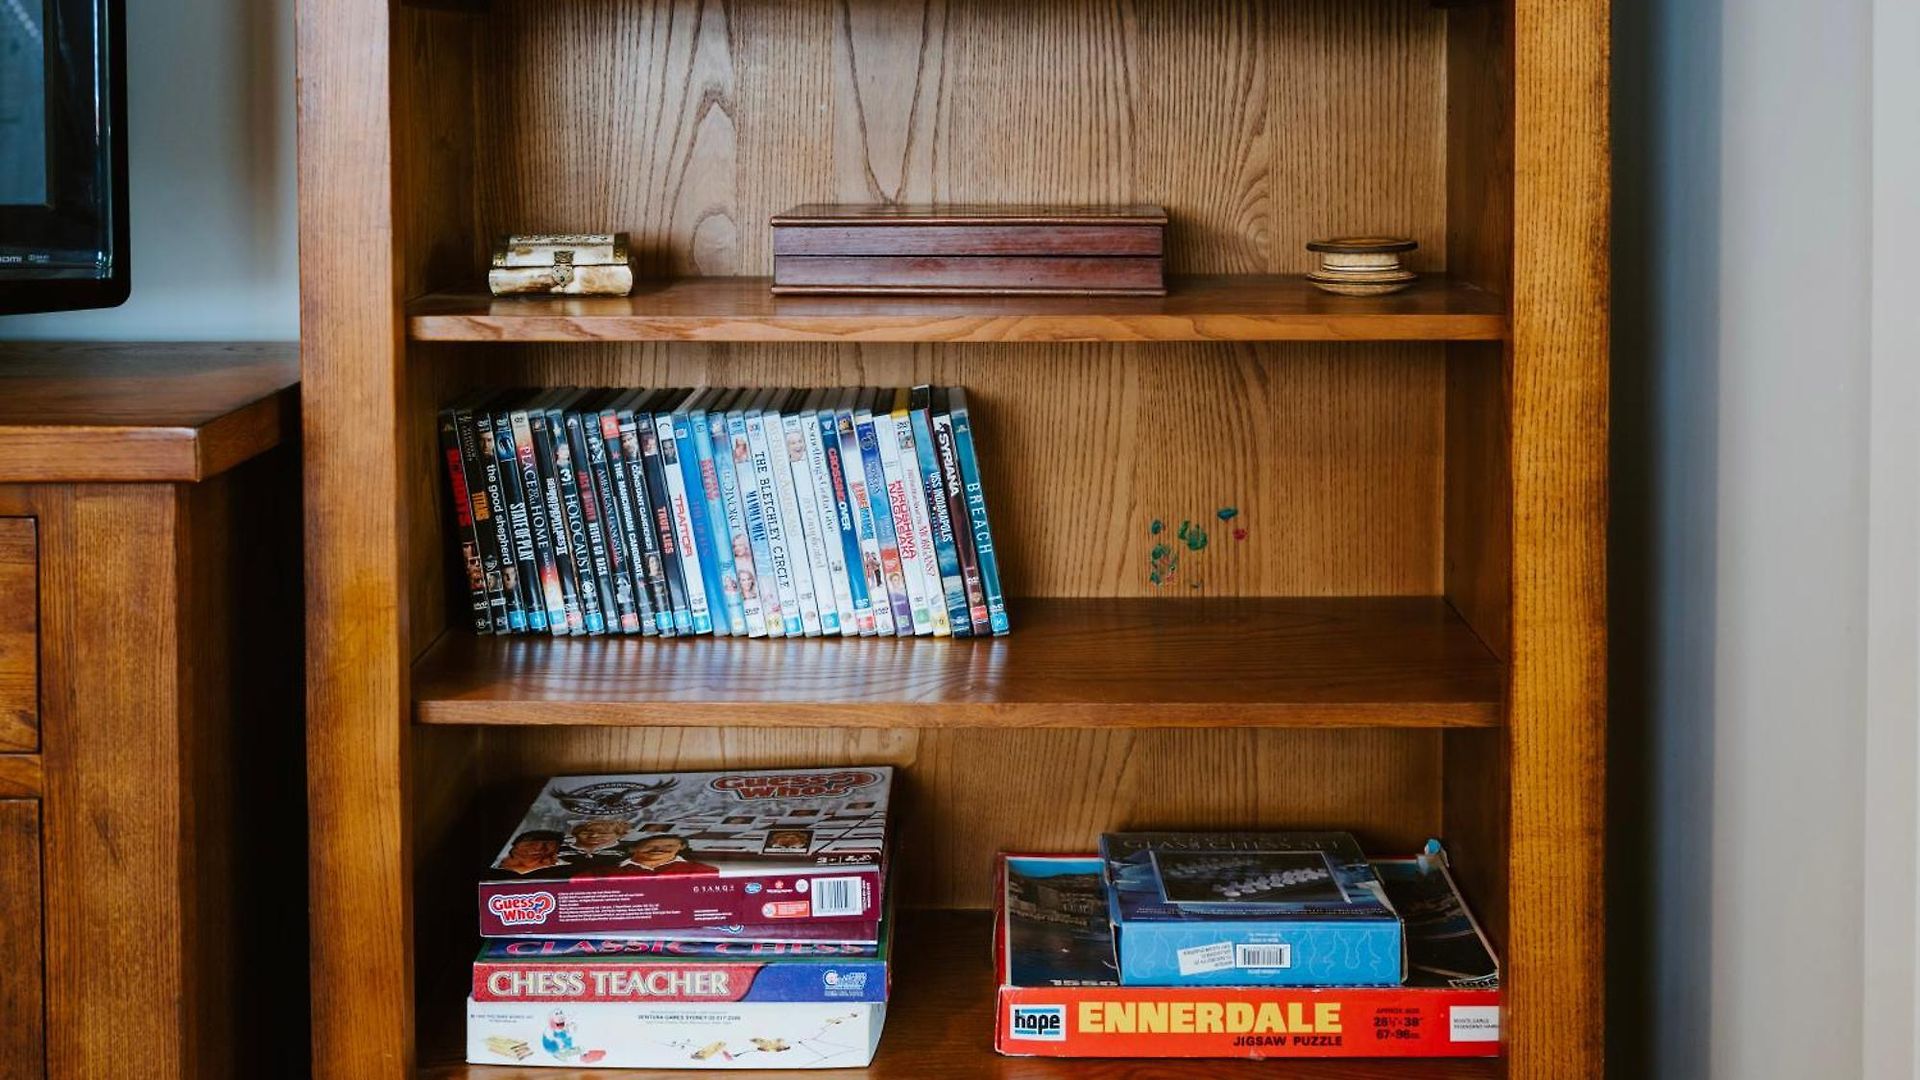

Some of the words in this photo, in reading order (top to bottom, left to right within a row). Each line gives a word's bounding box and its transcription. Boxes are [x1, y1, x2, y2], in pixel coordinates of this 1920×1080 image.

[486, 464, 497, 482] the
[754, 451, 767, 474] THE
[937, 432, 960, 497] SYRIANA
[597, 467, 612, 514] AMERICAN
[631, 464, 644, 506] CONSTANT
[826, 446, 846, 502] CROSSING
[837, 500, 852, 531] OVER
[929, 471, 941, 488] USS
[472, 491, 491, 521] TITANS
[488, 484, 502, 512] good
[519, 445, 536, 489] PLACE
[530, 504, 548, 548] HOME
[744, 489, 761, 521] MAMMA
[759, 477, 780, 542] BLETCHLEY
[509, 502, 528, 528] STATE
[613, 462, 623, 480] THE
[628, 532, 643, 578] CANDIDATE
[656, 505, 669, 532] TRUE
[673, 493, 693, 557] TRAITOR
[887, 482, 909, 560] NAGASAKI
[895, 479, 917, 559] HIROSHIMA
[932, 487, 953, 542] INDIANAPOLIS
[967, 482, 992, 554] BREACH
[493, 514, 512, 565] shepherd
[514, 527, 530, 540] OF
[564, 494, 591, 575] HOLOCAUST
[661, 533, 674, 554] LIES
[516, 538, 533, 562] PLAY
[772, 545, 789, 589] CIRCLE
[714, 776, 828, 790] Guess
[492, 897, 535, 911] Guess
[506, 941, 698, 955] CLASSIC
[487, 970, 586, 996] CHESS
[589, 970, 731, 996] TEACHER
[1014, 1008, 1061, 1034] hope
[1078, 1001, 1343, 1033] ENNERDALE
[1233, 1036, 1287, 1047] JIGSAW
[1293, 1036, 1343, 1047] PUZZLE
